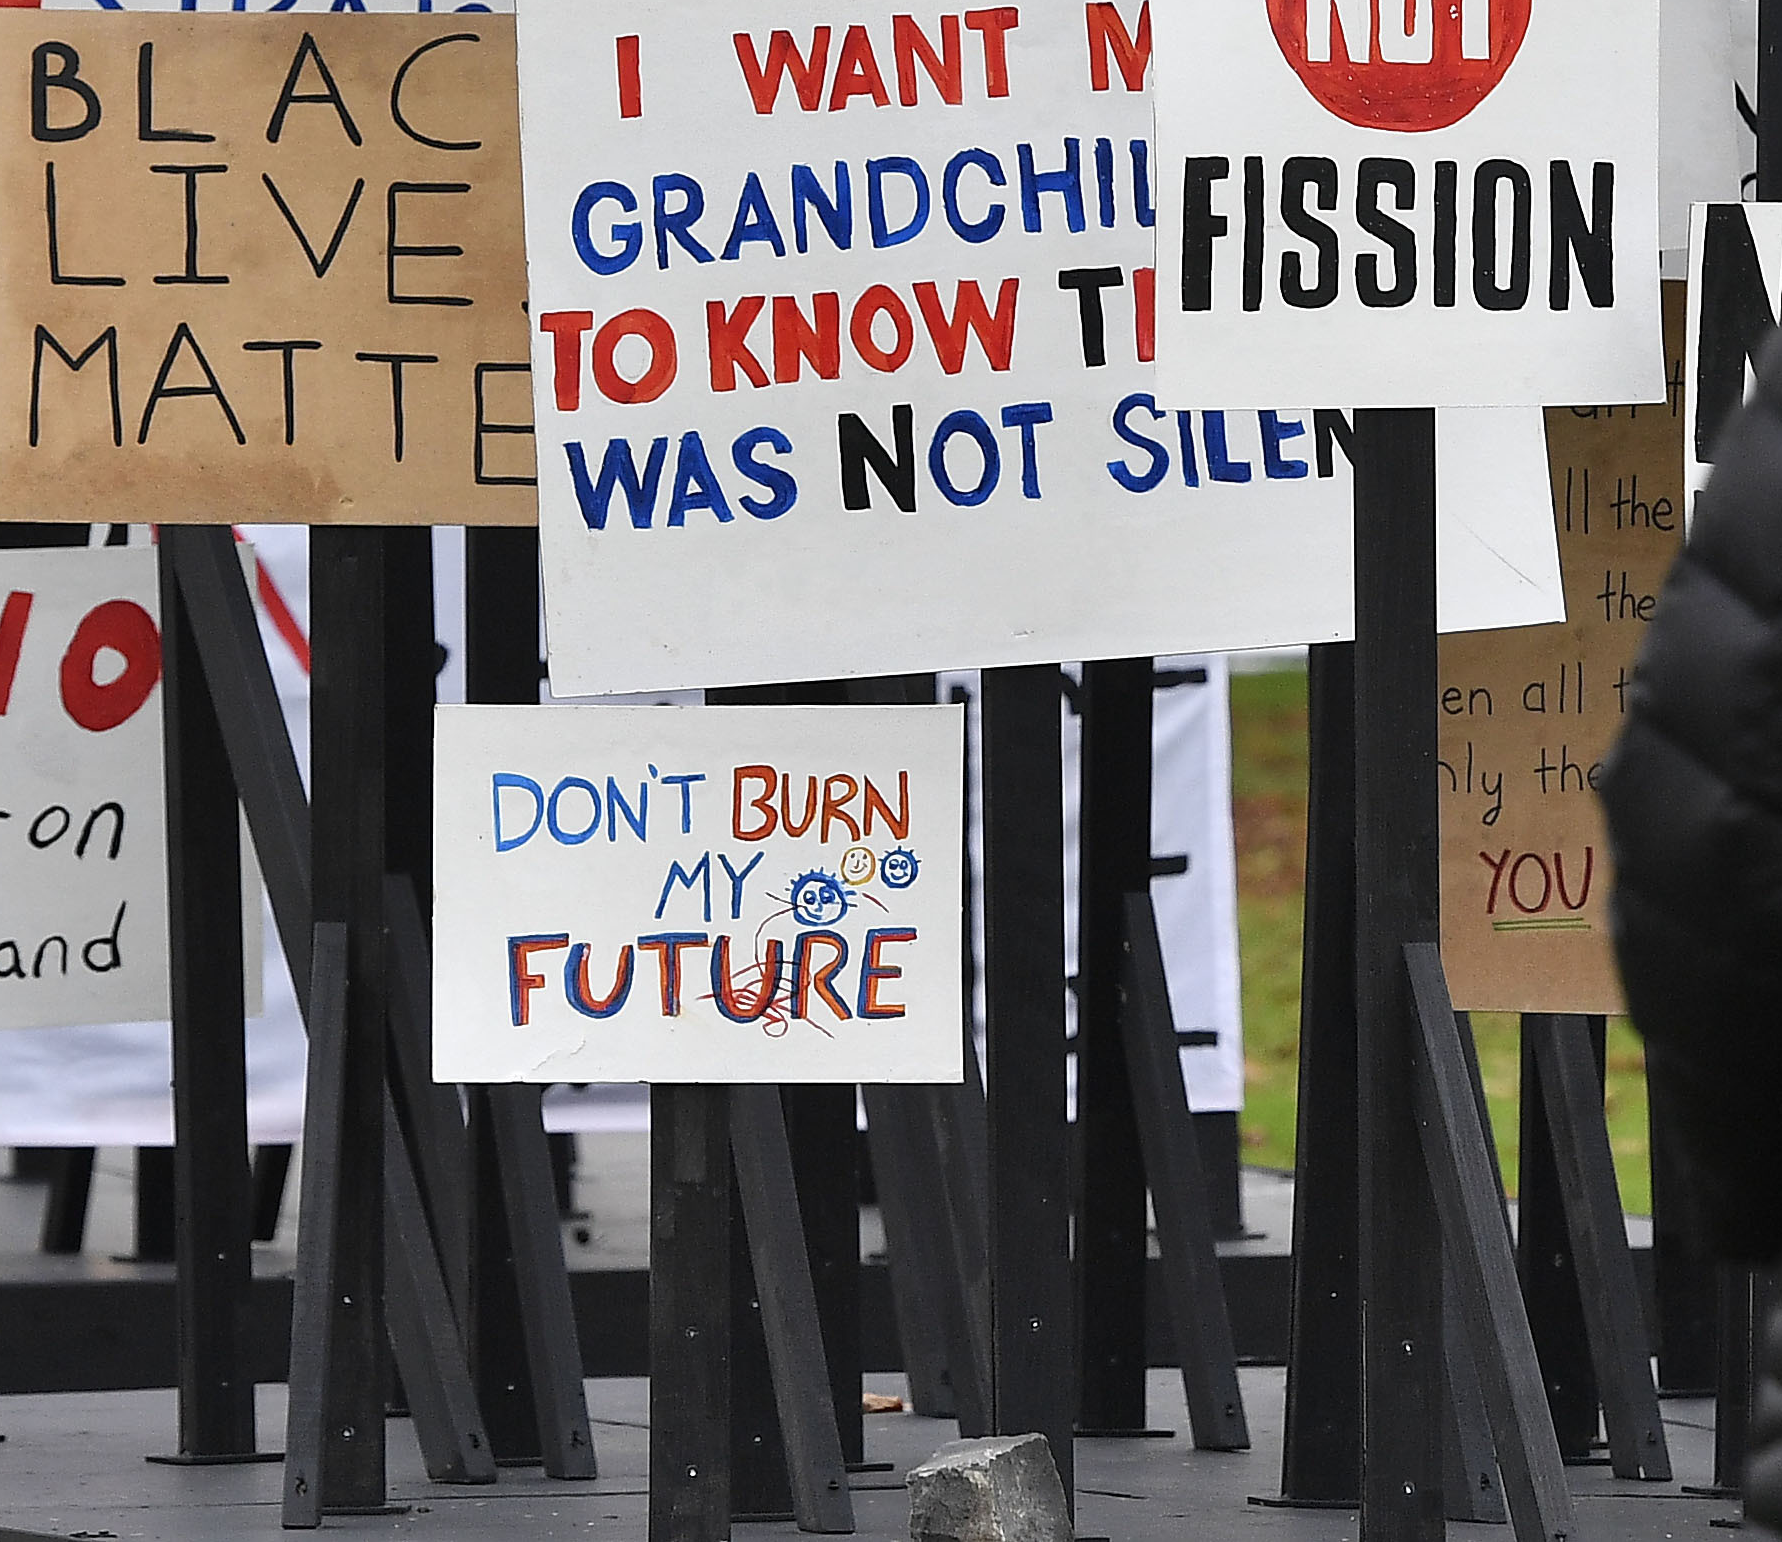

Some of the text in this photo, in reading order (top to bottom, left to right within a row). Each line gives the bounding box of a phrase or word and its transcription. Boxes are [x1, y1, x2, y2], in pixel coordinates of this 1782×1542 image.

[30, 31, 482, 151] BLAC
[614, 33, 644, 119] I
[731, 4, 1020, 116] WANT
[44, 160, 474, 308] LIVE
[1180, 155, 1617, 314] FISSION
[539, 304, 678, 414] TO
[706, 276, 1021, 396] KNOW
[28, 321, 539, 487] MATTE
[563, 425, 799, 533] WAS
[836, 399, 1053, 516] NOT
[1609, 474, 1675, 532] the
[1522, 661, 1584, 715] all
[491, 762, 910, 853] DON'T BURN
[654, 850, 765, 922] MY
[1478, 846, 1594, 915] YOU
[506, 927, 918, 1028] FUTURE
